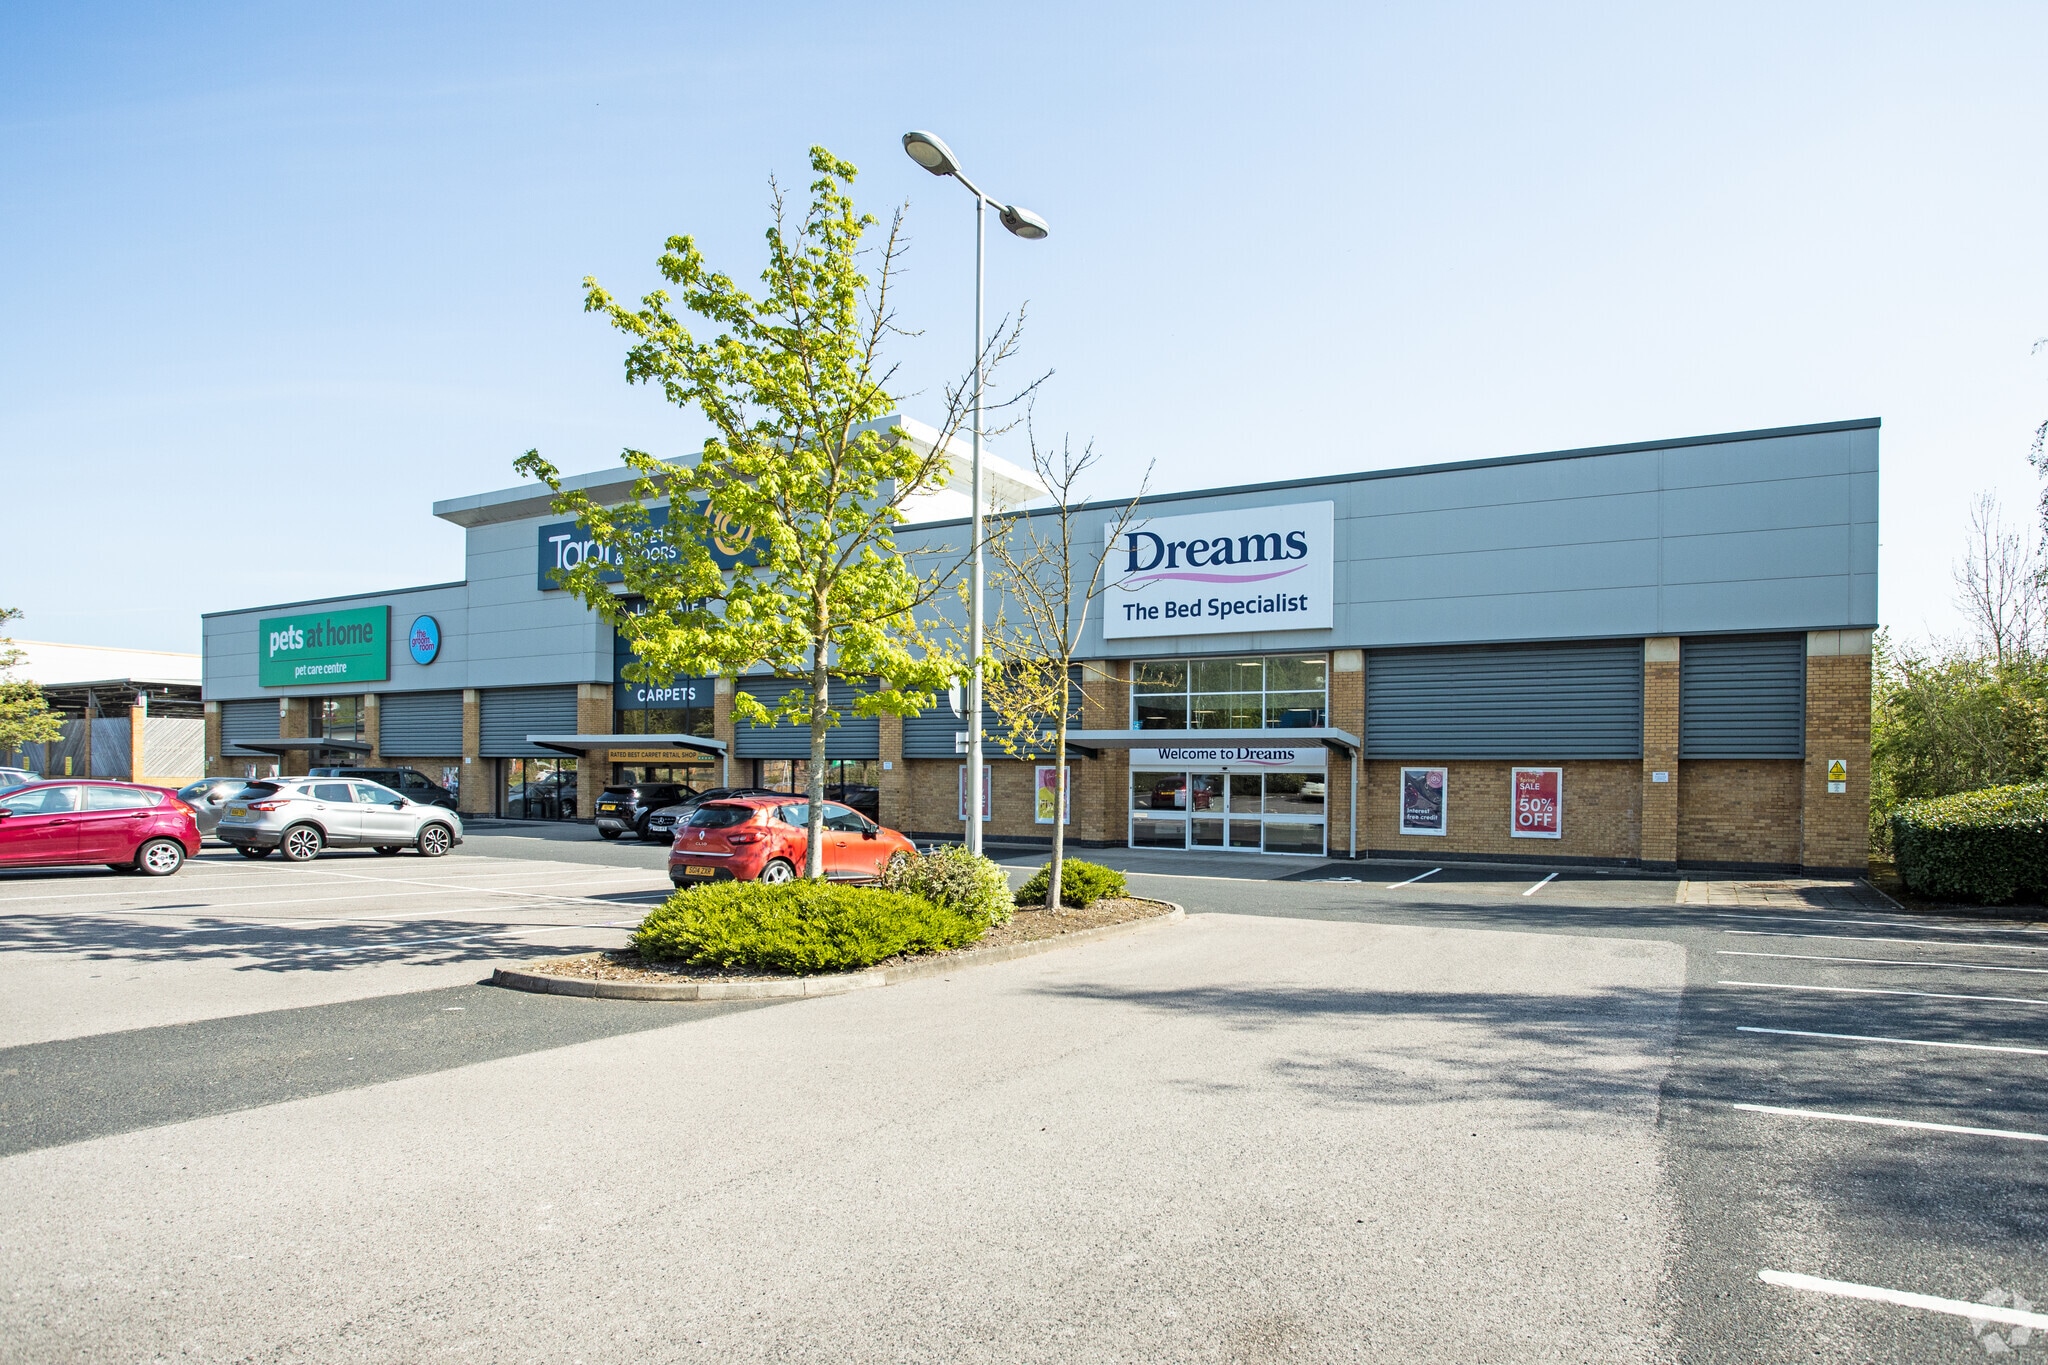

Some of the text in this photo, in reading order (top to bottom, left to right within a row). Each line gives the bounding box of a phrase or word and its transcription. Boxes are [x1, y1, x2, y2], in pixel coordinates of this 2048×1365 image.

[615, 552, 624, 565] &
[1124, 530, 1308, 573] Dreams
[1123, 593, 1308, 621] The Bed Specialist
[269, 619, 373, 658] pets at home
[416, 629, 426, 638] the
[420, 643, 435, 651] room
[295, 662, 347, 679] pet care centre
[637, 687, 696, 702] CARPETS
[1158, 747, 1295, 760] Welcome to Dreams
[1519, 782, 1540, 791] SALE
[1519, 798, 1553, 812] 50%
[1519, 812, 1553, 827] OFF
